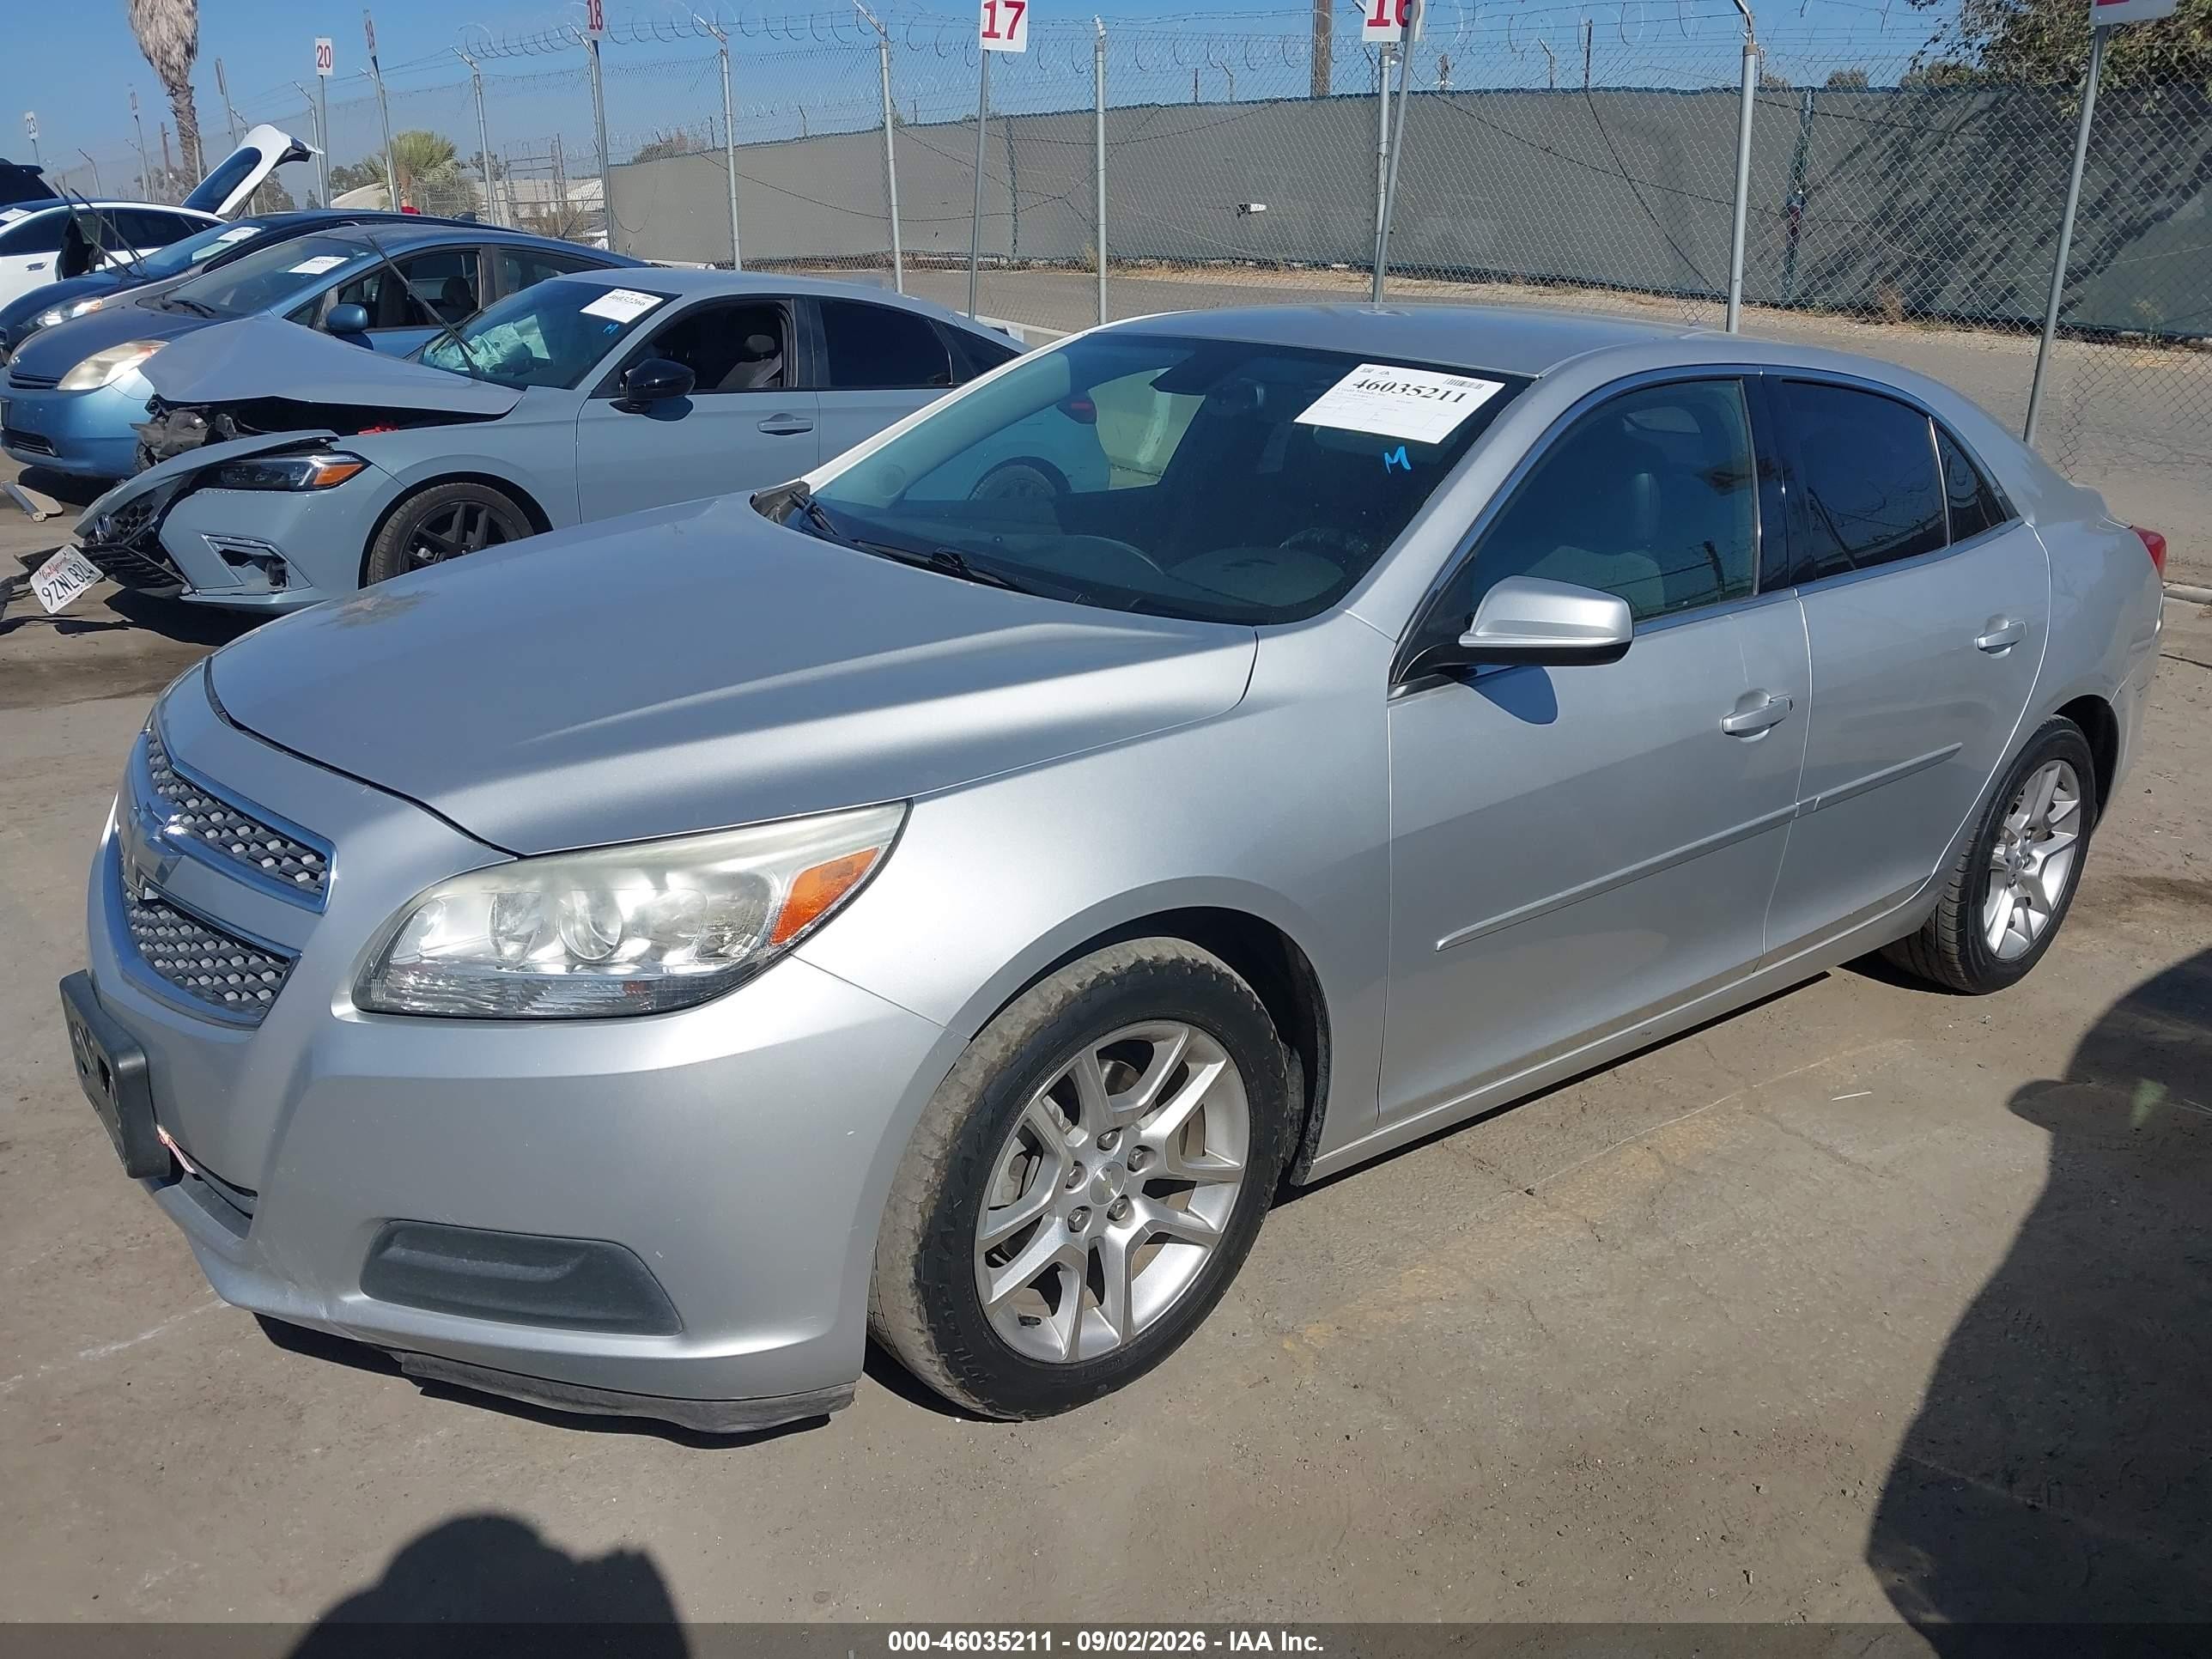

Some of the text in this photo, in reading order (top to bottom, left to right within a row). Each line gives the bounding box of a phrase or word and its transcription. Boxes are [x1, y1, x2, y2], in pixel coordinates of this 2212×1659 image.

[587, 0, 603, 30] 18
[981, 0, 1025, 40] 17
[316, 45, 331, 69] 20
[27, 117, 36, 134] 23
[1352, 378, 1468, 403] 46035211
[1383, 446, 1412, 474] M
